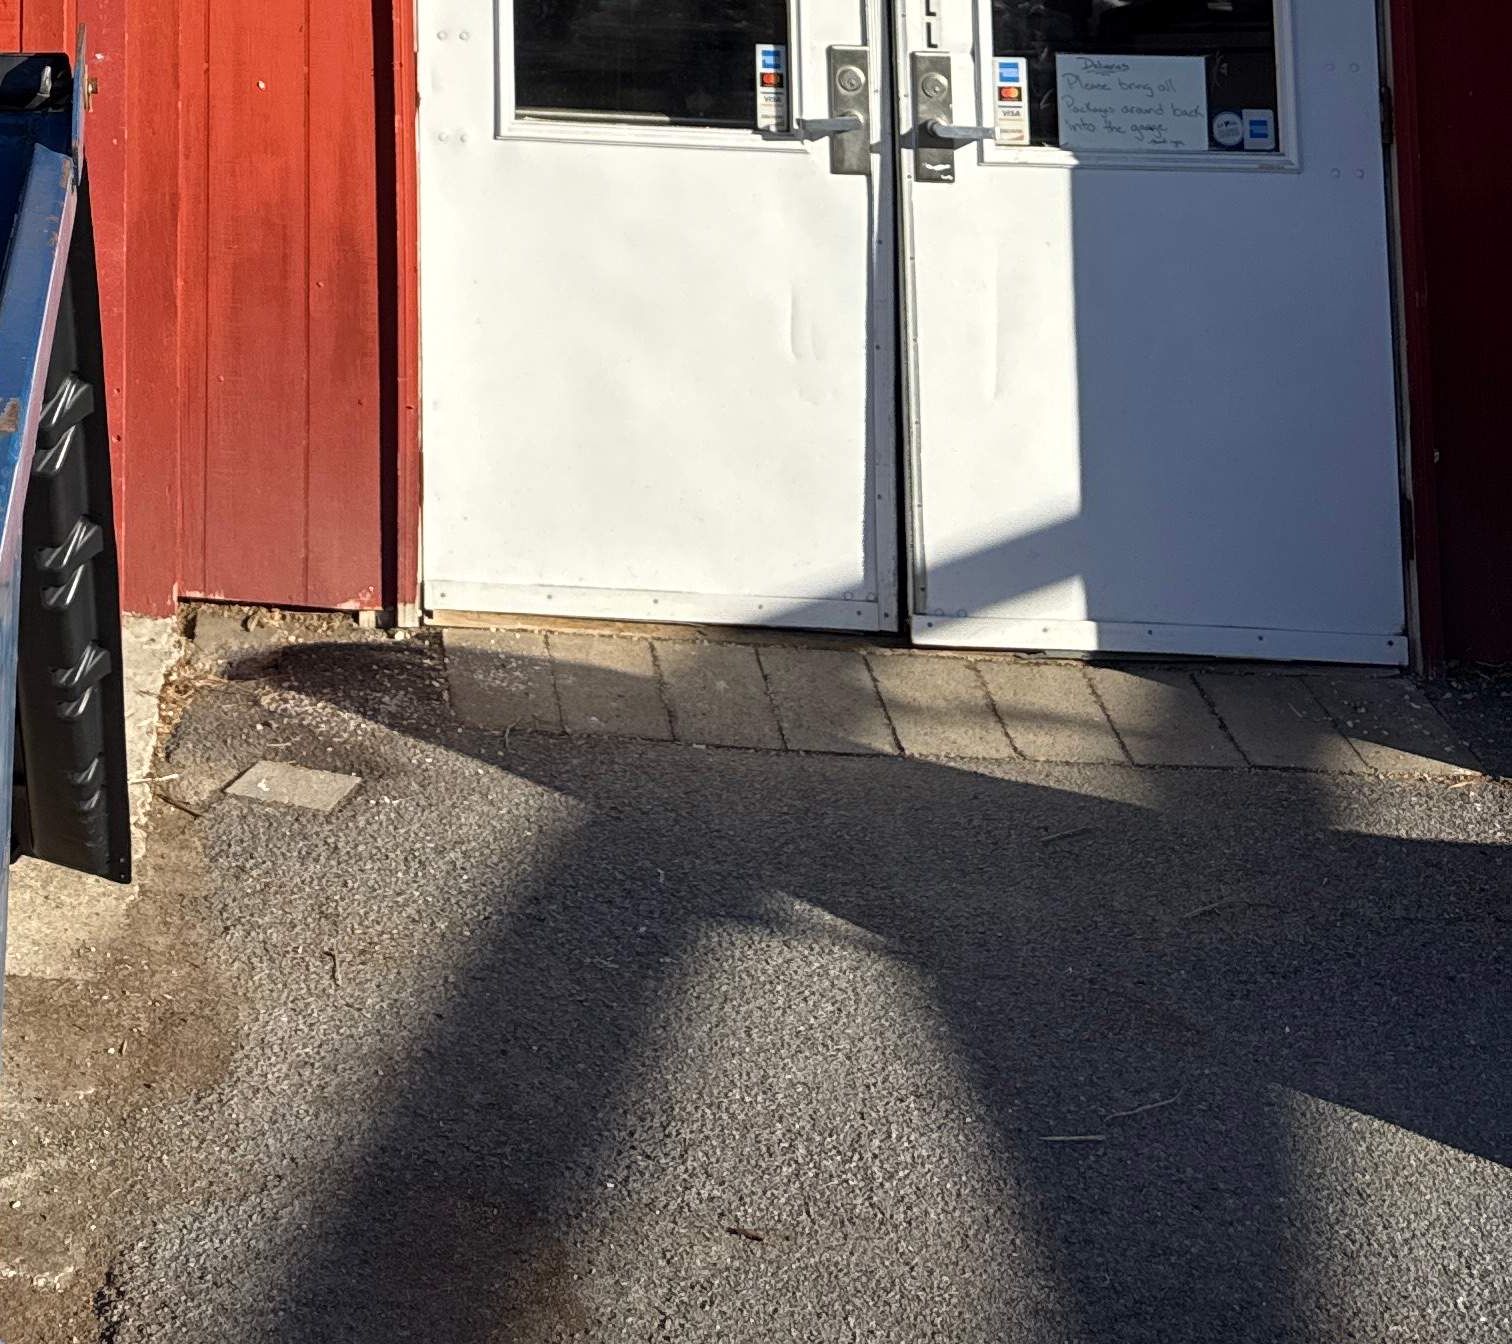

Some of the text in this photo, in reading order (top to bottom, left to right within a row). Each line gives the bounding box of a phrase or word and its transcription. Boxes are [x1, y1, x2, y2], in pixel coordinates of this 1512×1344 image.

[1061, 72, 1177, 98] Please bring all
[1120, 103, 1165, 116] around
[1170, 102, 1205, 118] back
[1103, 119, 1126, 134] the
